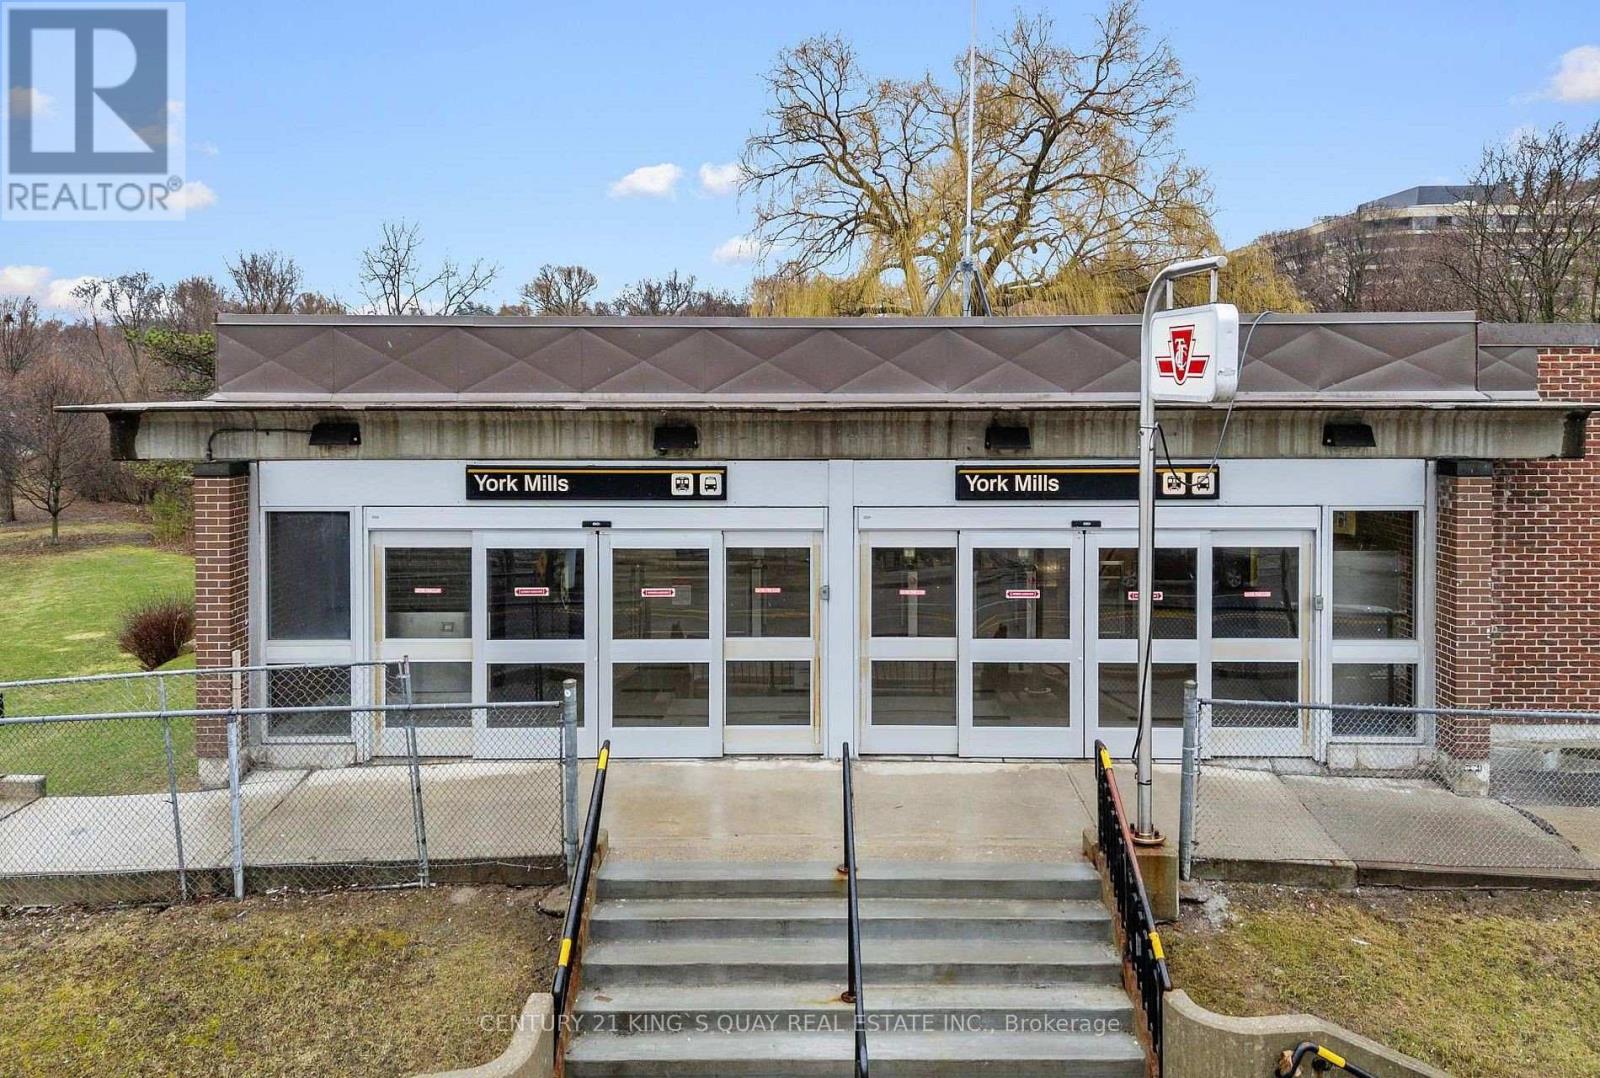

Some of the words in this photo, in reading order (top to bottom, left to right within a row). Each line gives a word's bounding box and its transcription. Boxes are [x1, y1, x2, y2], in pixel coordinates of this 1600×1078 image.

[474, 474, 519, 492] York
[524, 474, 569, 492] Mills
[965, 474, 1009, 492] York
[1015, 474, 1060, 492] Mills
